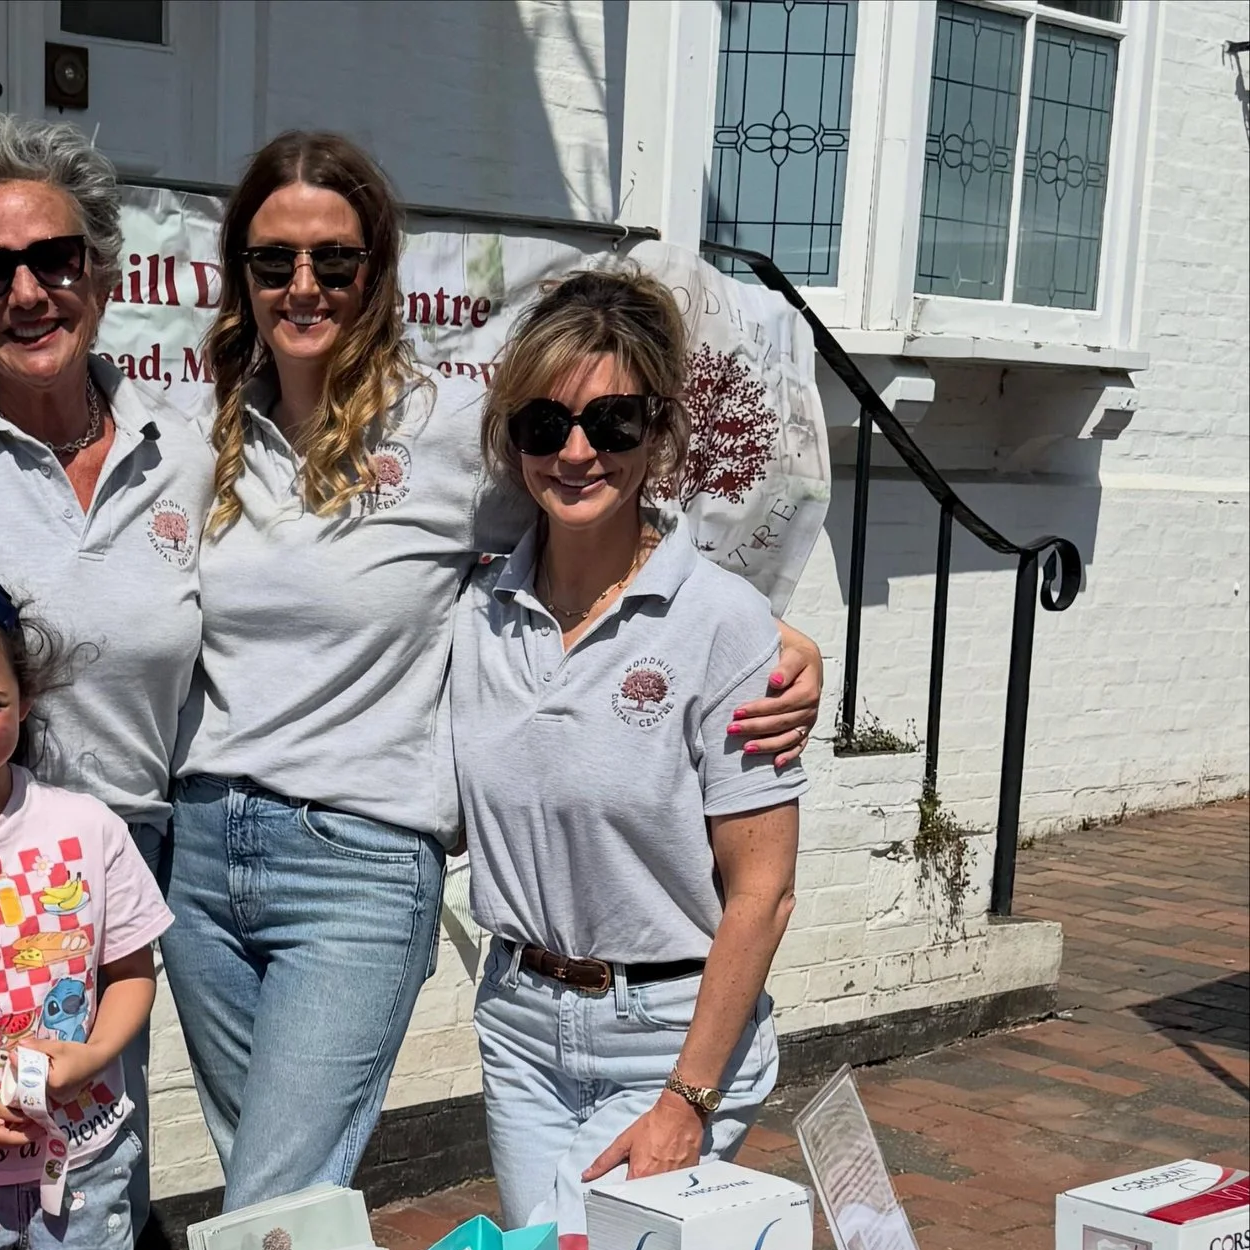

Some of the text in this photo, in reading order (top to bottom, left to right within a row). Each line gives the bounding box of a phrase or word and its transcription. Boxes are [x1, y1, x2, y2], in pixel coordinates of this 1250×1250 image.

[405, 285, 491, 328] ntre
[625, 657, 676, 681] WOODHILL
[611, 693, 631, 725] DENTAL
[639, 702, 674, 727] CENTRE
[678, 1180, 751, 1199] SENSODYNE
